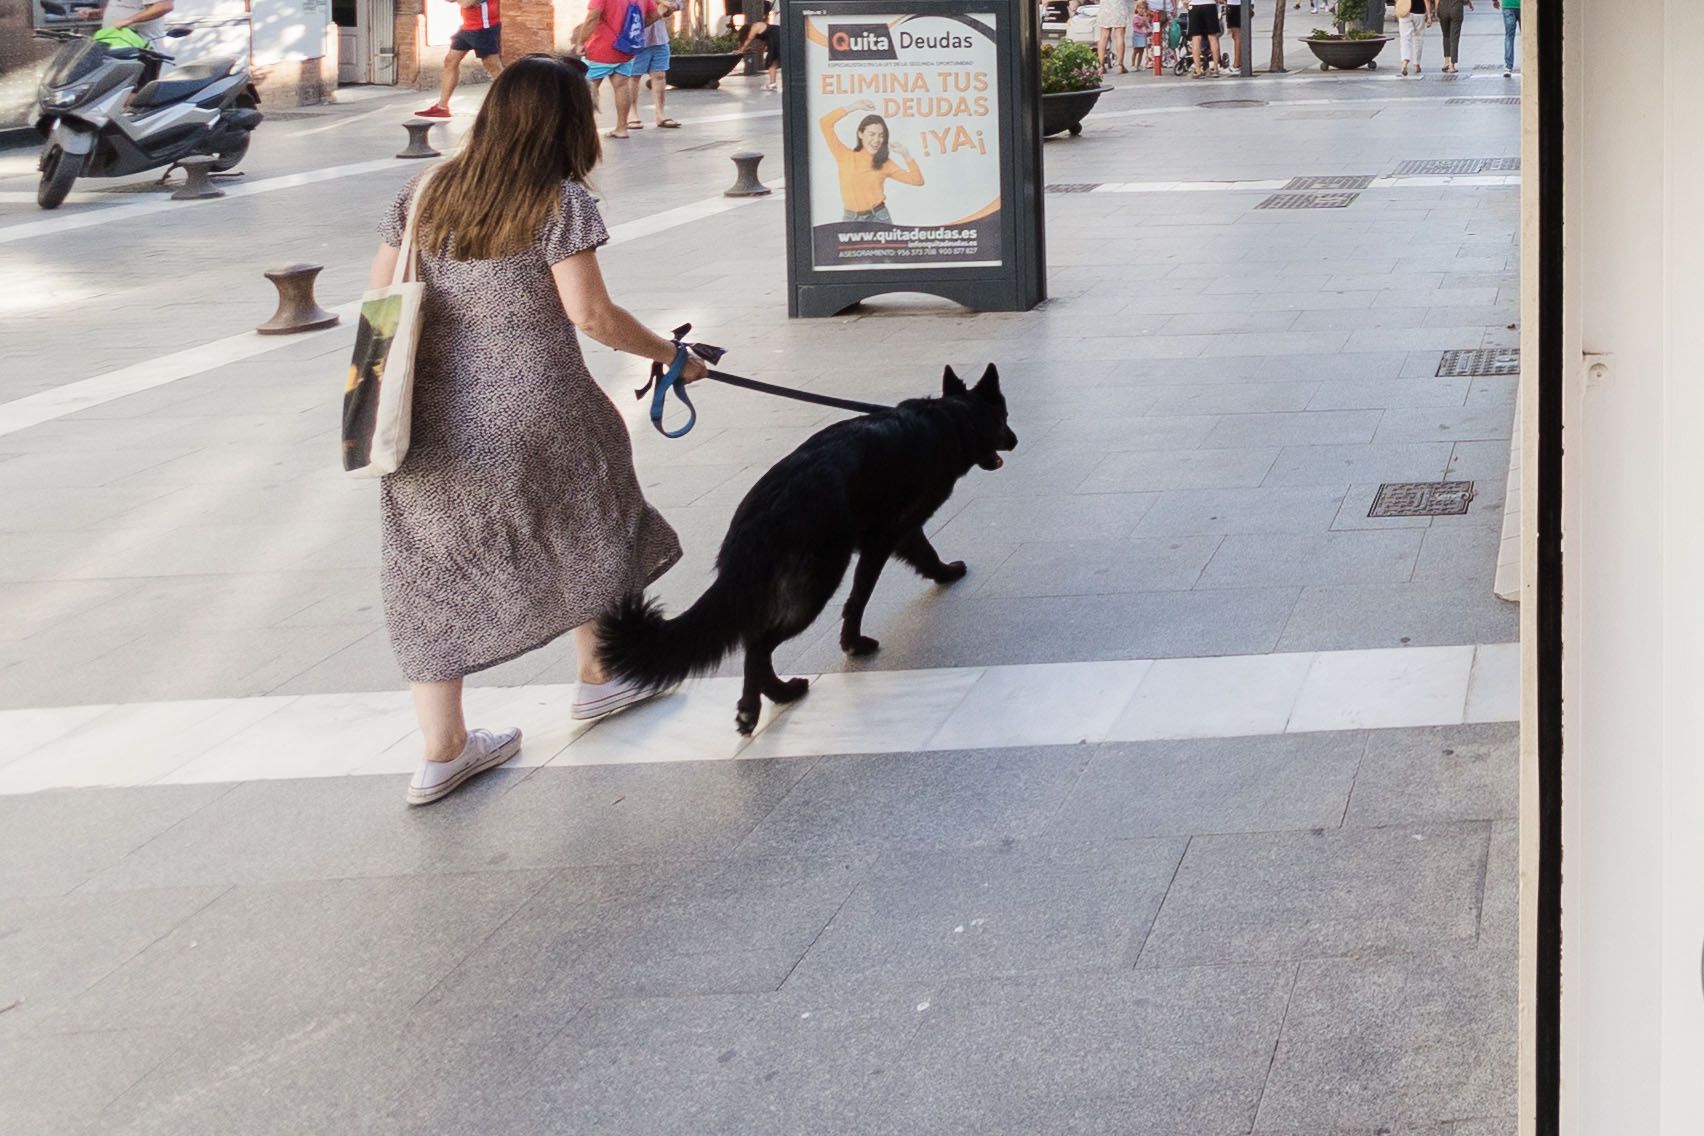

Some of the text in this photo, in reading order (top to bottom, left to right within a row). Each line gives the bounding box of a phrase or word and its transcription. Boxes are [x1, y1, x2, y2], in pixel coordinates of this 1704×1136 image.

[832, 31, 973, 52] Quita Deudas
[820, 71, 989, 95] ELIMINA TUS
[883, 96, 990, 118] DEUDAS
[838, 226, 978, 244] www.quitadeudas.es
